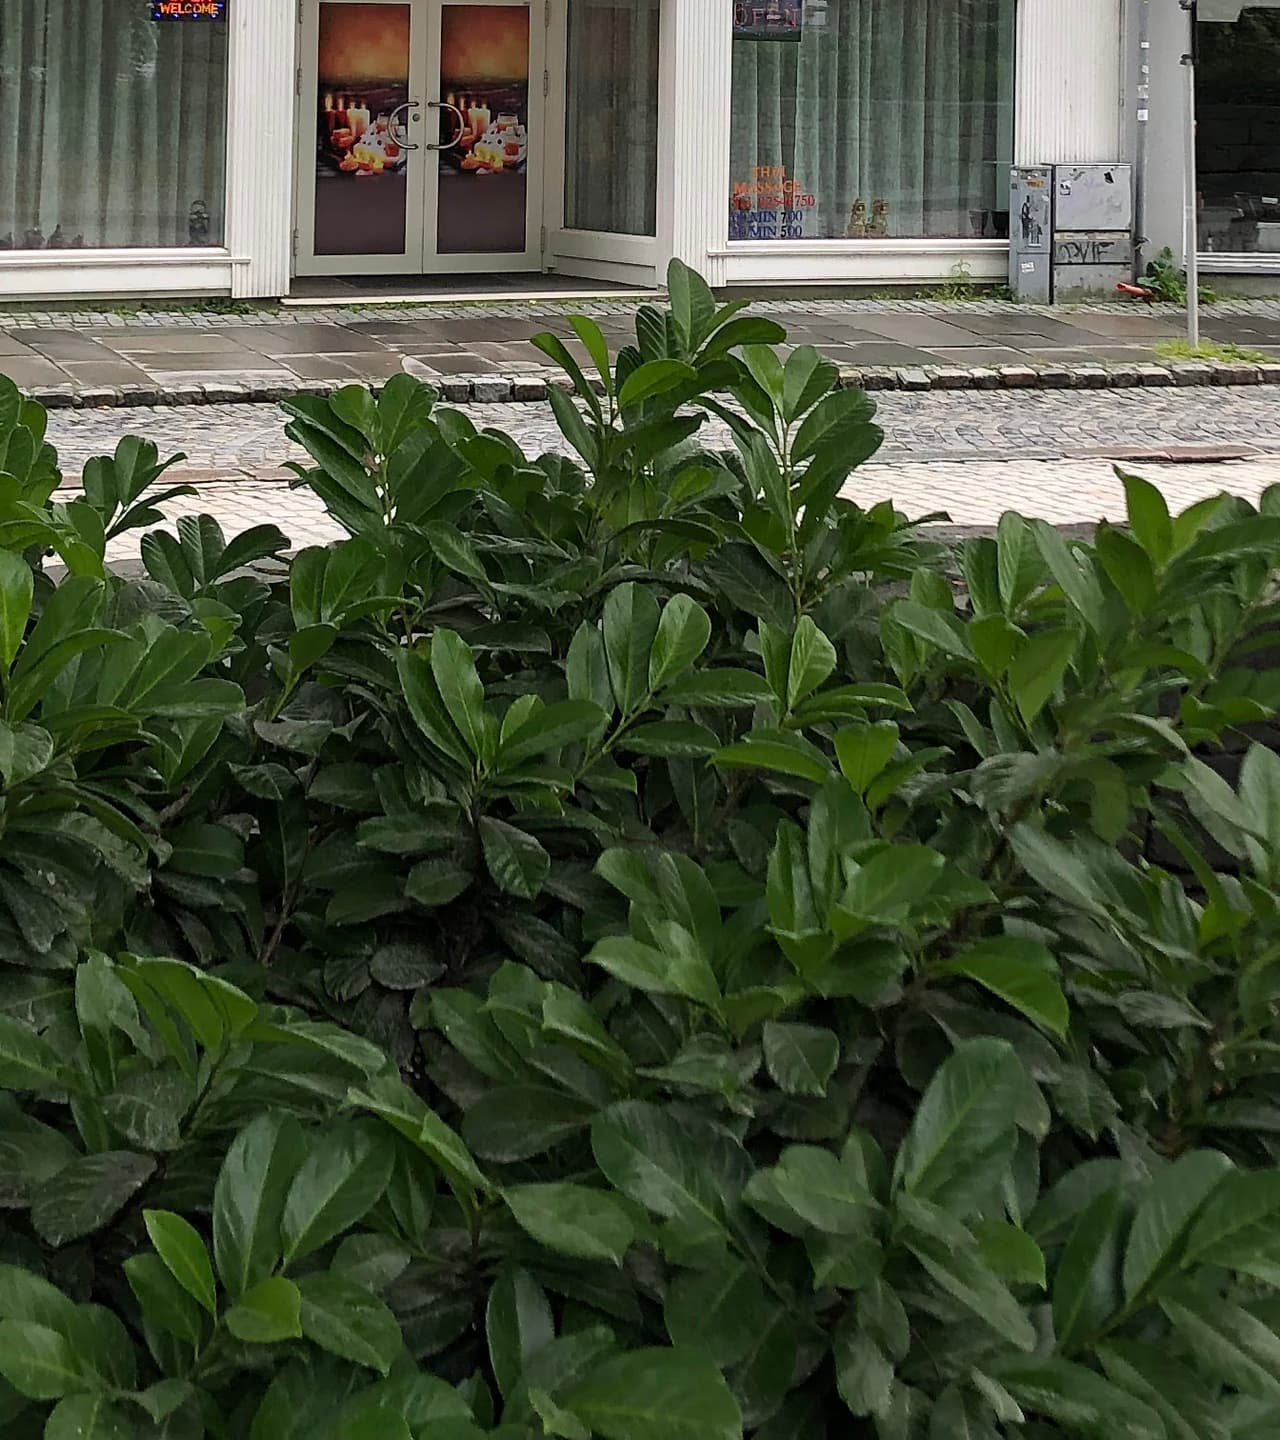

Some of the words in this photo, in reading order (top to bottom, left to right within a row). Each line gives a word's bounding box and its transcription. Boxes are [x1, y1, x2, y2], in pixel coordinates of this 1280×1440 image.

[159, 3, 219, 14] WELCOME
[750, 211, 777, 222] MIN
[780, 210, 803, 224] 700
[750, 225, 777, 238] MIN
[780, 224, 803, 238] 500
